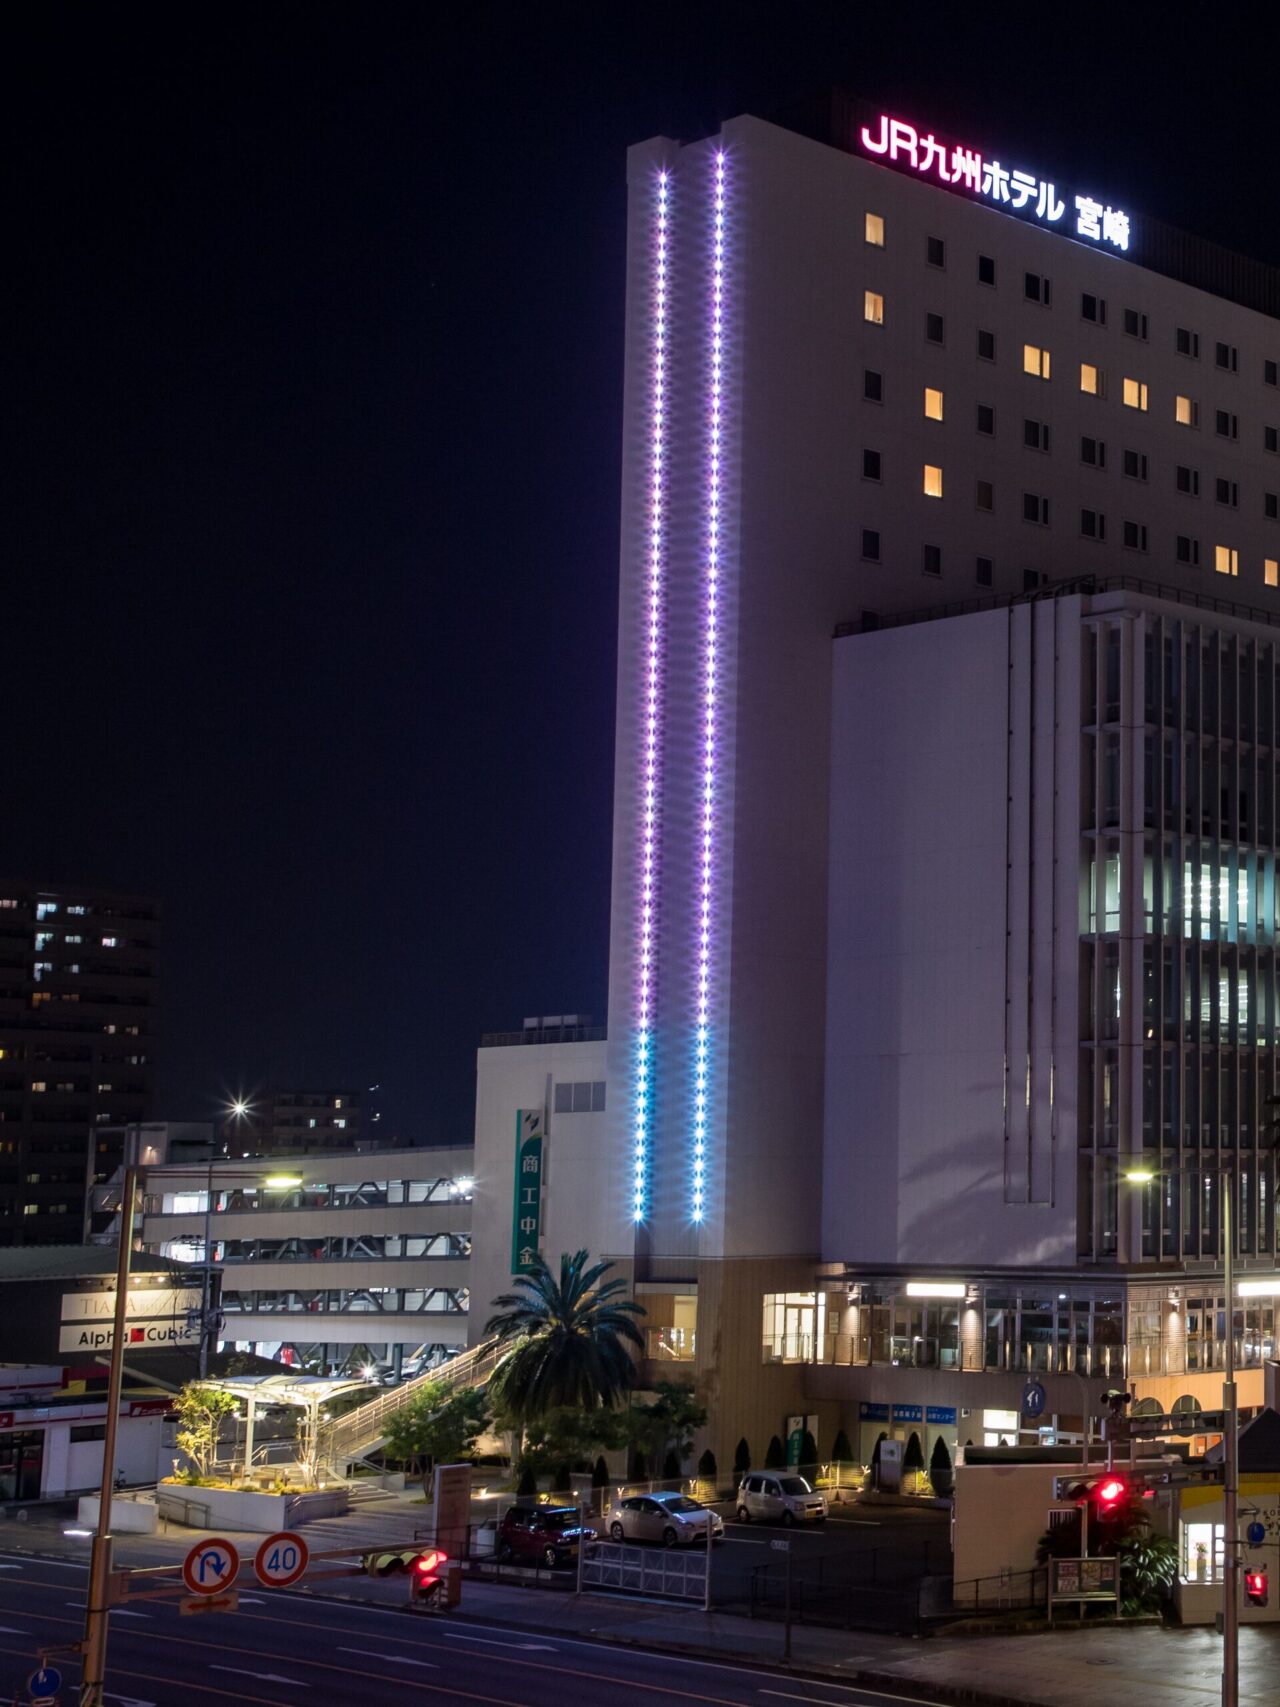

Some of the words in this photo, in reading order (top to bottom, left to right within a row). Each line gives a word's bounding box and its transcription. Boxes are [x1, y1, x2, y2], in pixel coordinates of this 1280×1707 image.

[861, 115, 1066, 222] JR九州ホテル
[1075, 194, 1131, 251] 宮崎
[519, 1155, 539, 1265] 商工中金
[80, 1297, 136, 1315] TIAA
[147, 1327, 191, 1341] Cubic
[267, 1547, 296, 1572] 40
